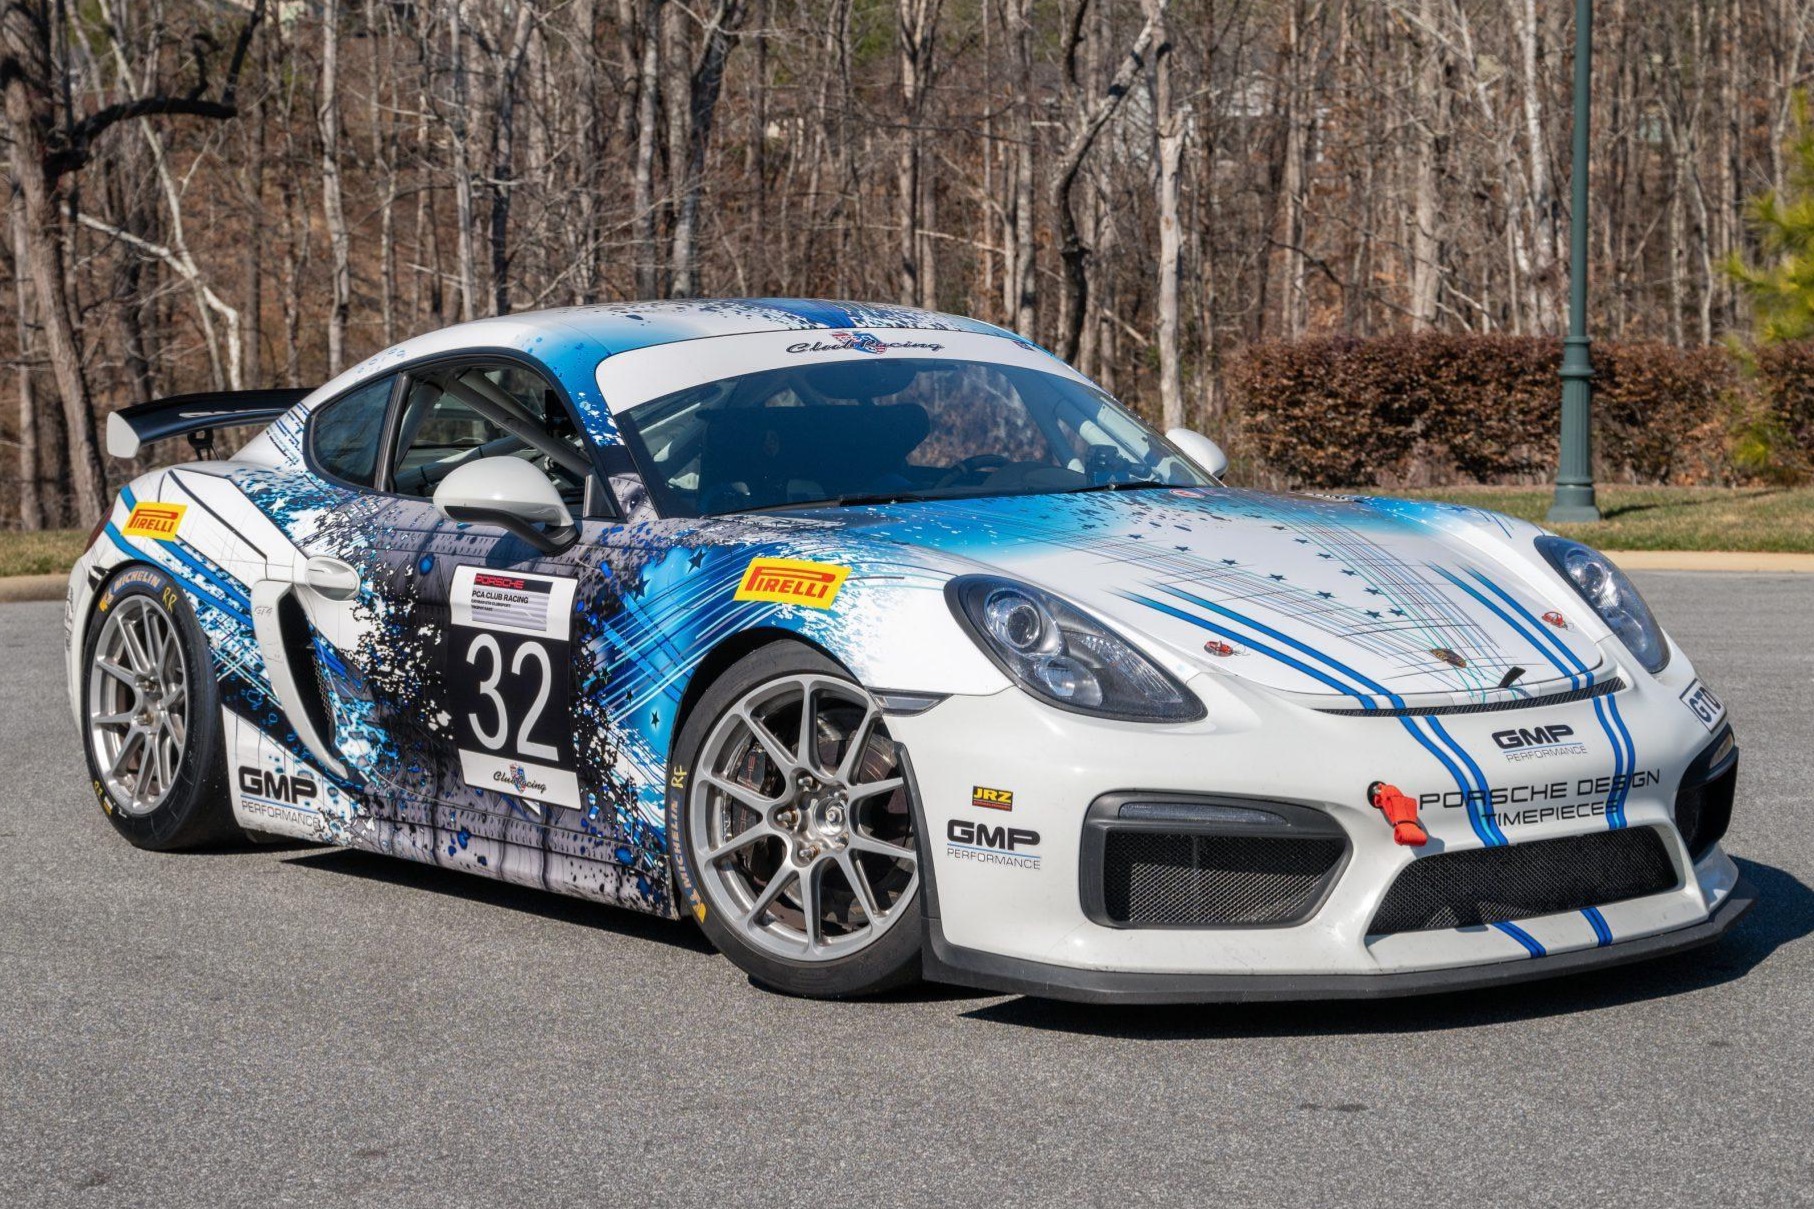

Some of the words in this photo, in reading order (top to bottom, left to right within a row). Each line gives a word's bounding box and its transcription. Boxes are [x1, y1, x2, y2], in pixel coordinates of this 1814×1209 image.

[787, 340, 855, 353] Club
[860, 339, 945, 354] Racing
[128, 509, 179, 533] PIRELLI
[113, 570, 161, 592] MICHELIN
[475, 575, 524, 589] PORSCHE
[745, 566, 836, 598] PIRELLI
[162, 586, 177, 613] RR
[472, 590, 485, 598] PCA
[485, 592, 502, 600] CLUB
[503, 594, 529, 604] RACING
[466, 633, 559, 761] 32
[1491, 724, 1574, 750] GMP
[1506, 745, 1588, 763] PERFORMANCE
[238, 765, 317, 804] GMP
[493, 771, 516, 785] Club
[671, 765, 688, 788] RF
[1419, 781, 1567, 810] PORSCHE
[1577, 768, 1661, 796] DESIGN
[973, 787, 1012, 804] JRZ
[242, 801, 320, 827] PERFORMANCE
[1482, 800, 1618, 827] TIMEPIECES
[671, 799, 692, 888] MICHELIN
[947, 819, 1041, 851] GMP
[947, 847, 1041, 870] PERFORMANCE
